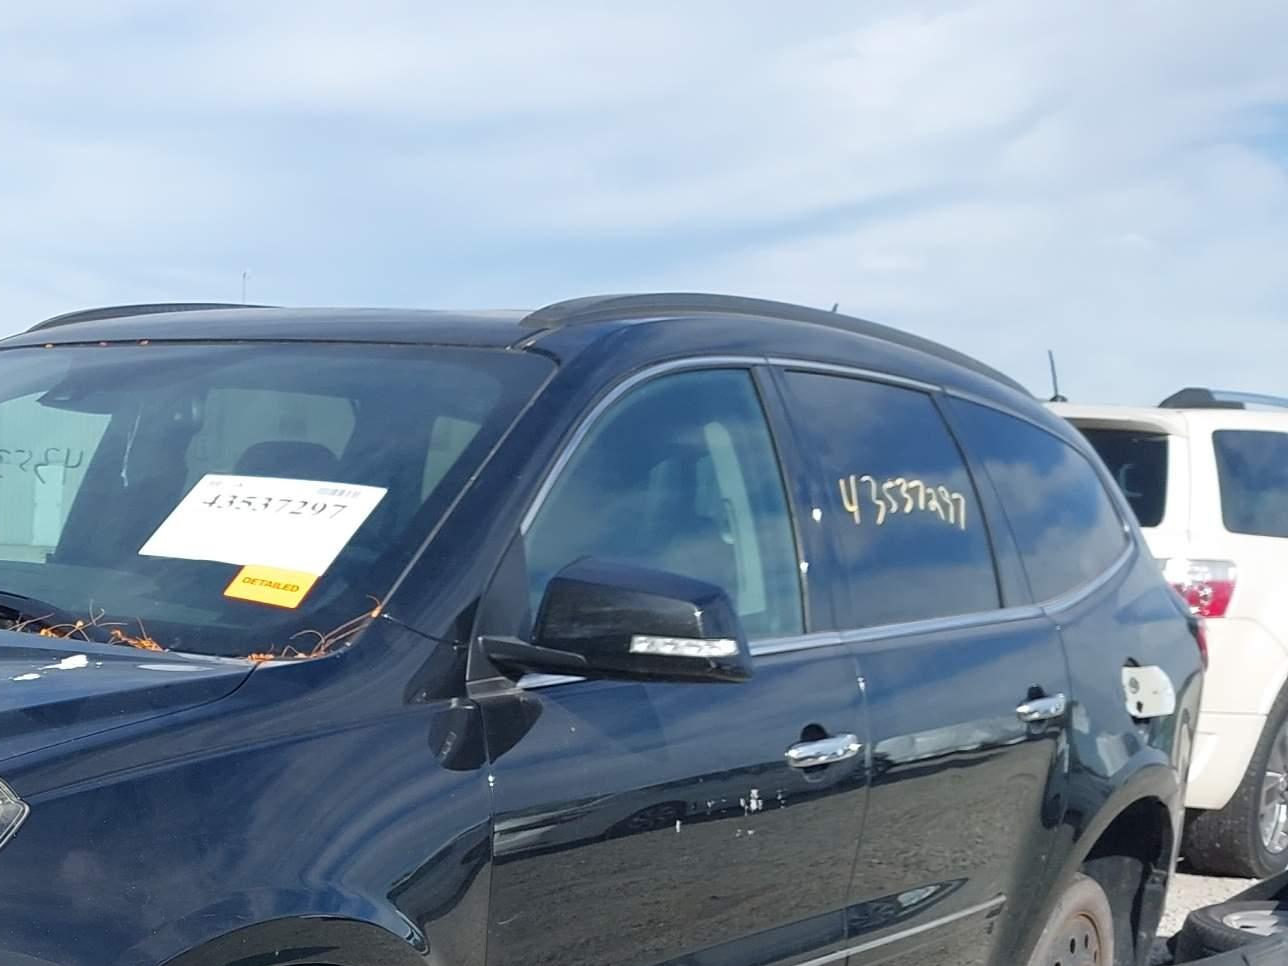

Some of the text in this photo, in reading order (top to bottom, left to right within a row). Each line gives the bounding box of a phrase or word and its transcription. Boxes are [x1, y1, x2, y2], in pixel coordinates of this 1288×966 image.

[203, 493, 348, 519] 43537297
[839, 474, 965, 530] 43537297
[242, 576, 300, 593] DETAILED
